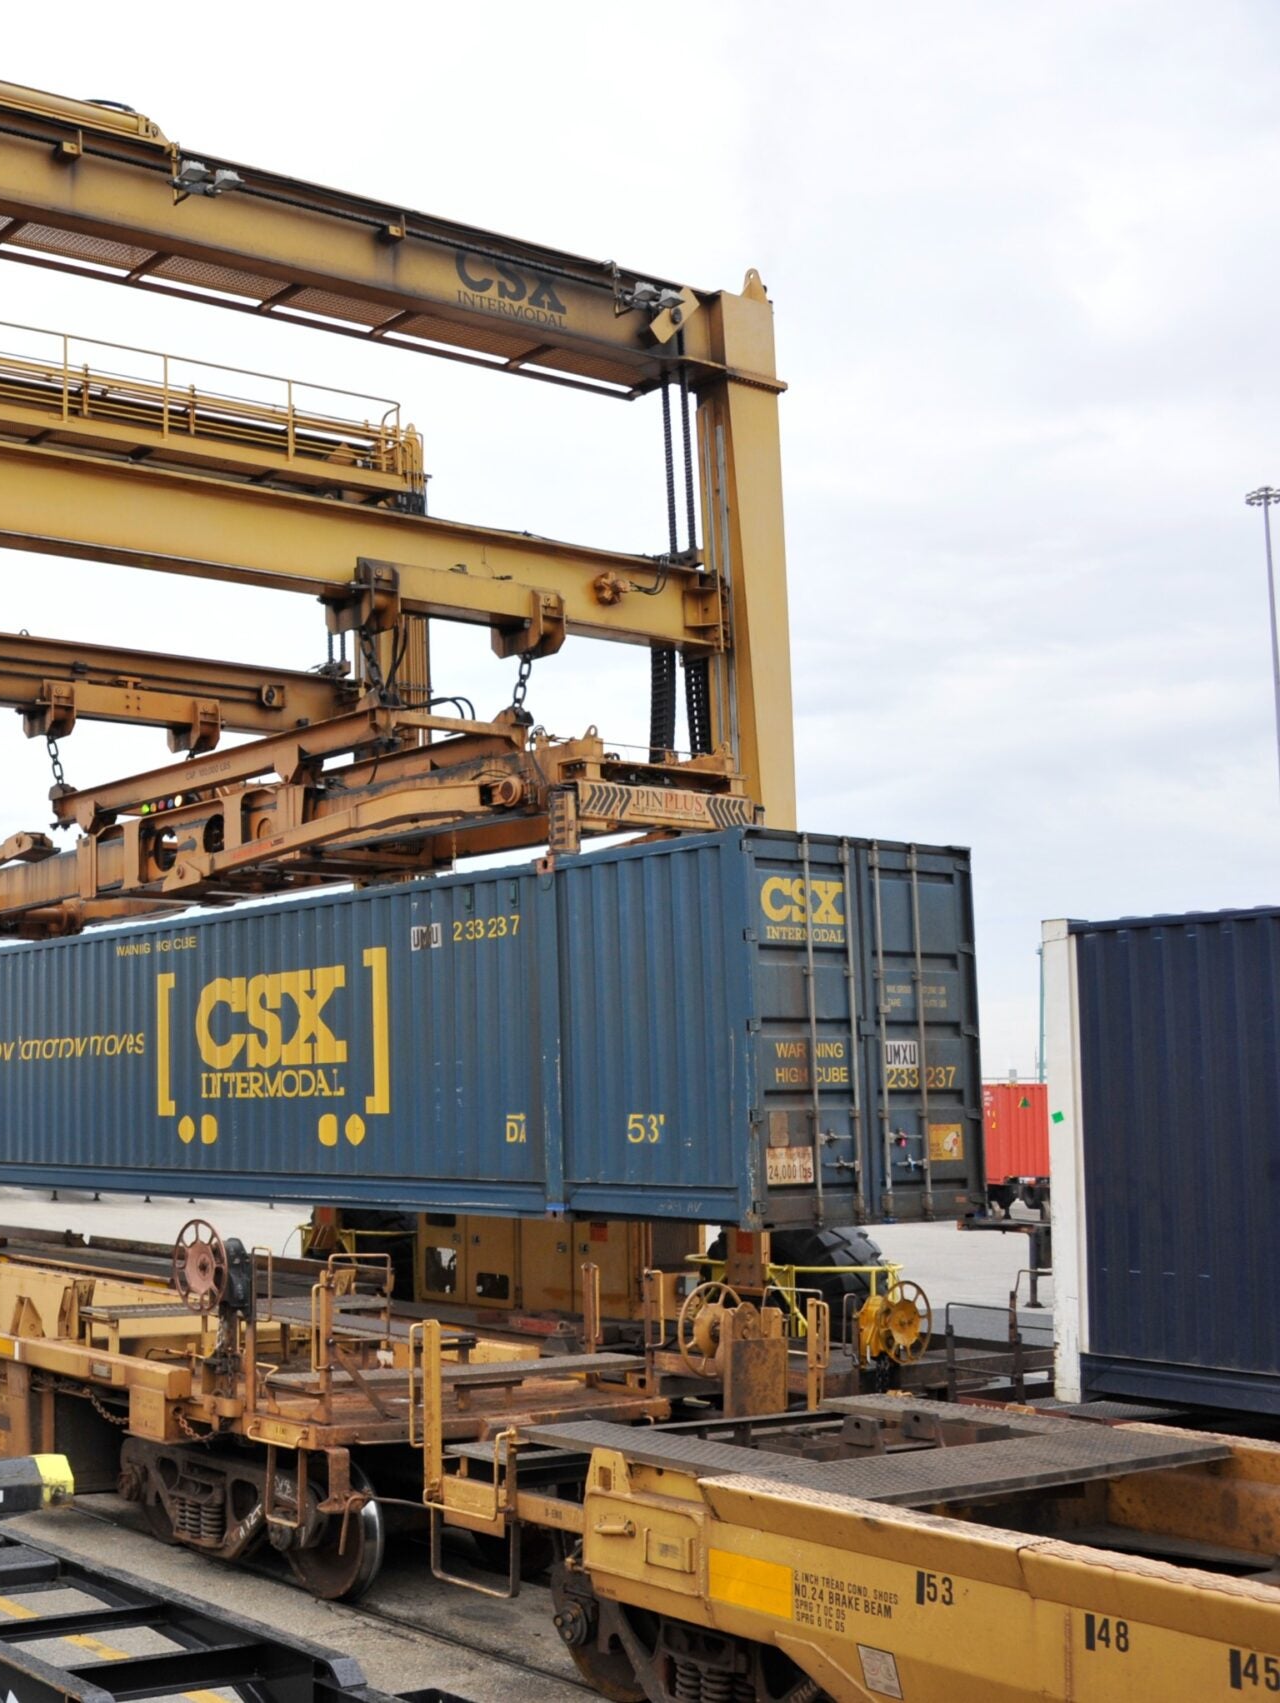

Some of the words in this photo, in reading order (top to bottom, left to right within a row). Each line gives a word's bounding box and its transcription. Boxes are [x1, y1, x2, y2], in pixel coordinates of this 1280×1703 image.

[454, 250, 567, 315] CSX
[457, 289, 567, 329] INTERMODAL
[761, 876, 845, 925] CSX
[195, 964, 348, 1069] CSX
[775, 1042, 845, 1059] WARNING
[885, 1044, 917, 1065] UMXU
[201, 1068, 345, 1098] INTERMODAL
[775, 1067, 809, 1083] HIGH
[816, 1067, 849, 1083] CUBE
[627, 1113, 666, 1144] 53'
[801, 1572, 819, 1586] INCH
[821, 1576, 845, 1592] TREAD
[873, 1589, 899, 1605] SHOES
[926, 1573, 955, 1606] 53
[795, 1599, 814, 1613] SPRG
[796, 1611, 815, 1625] SPRG
[829, 1591, 860, 1611] BRAKE
[864, 1600, 892, 1619] BEAM
[1097, 1618, 1129, 1652] 48
[1242, 1653, 1280, 1692] 45
